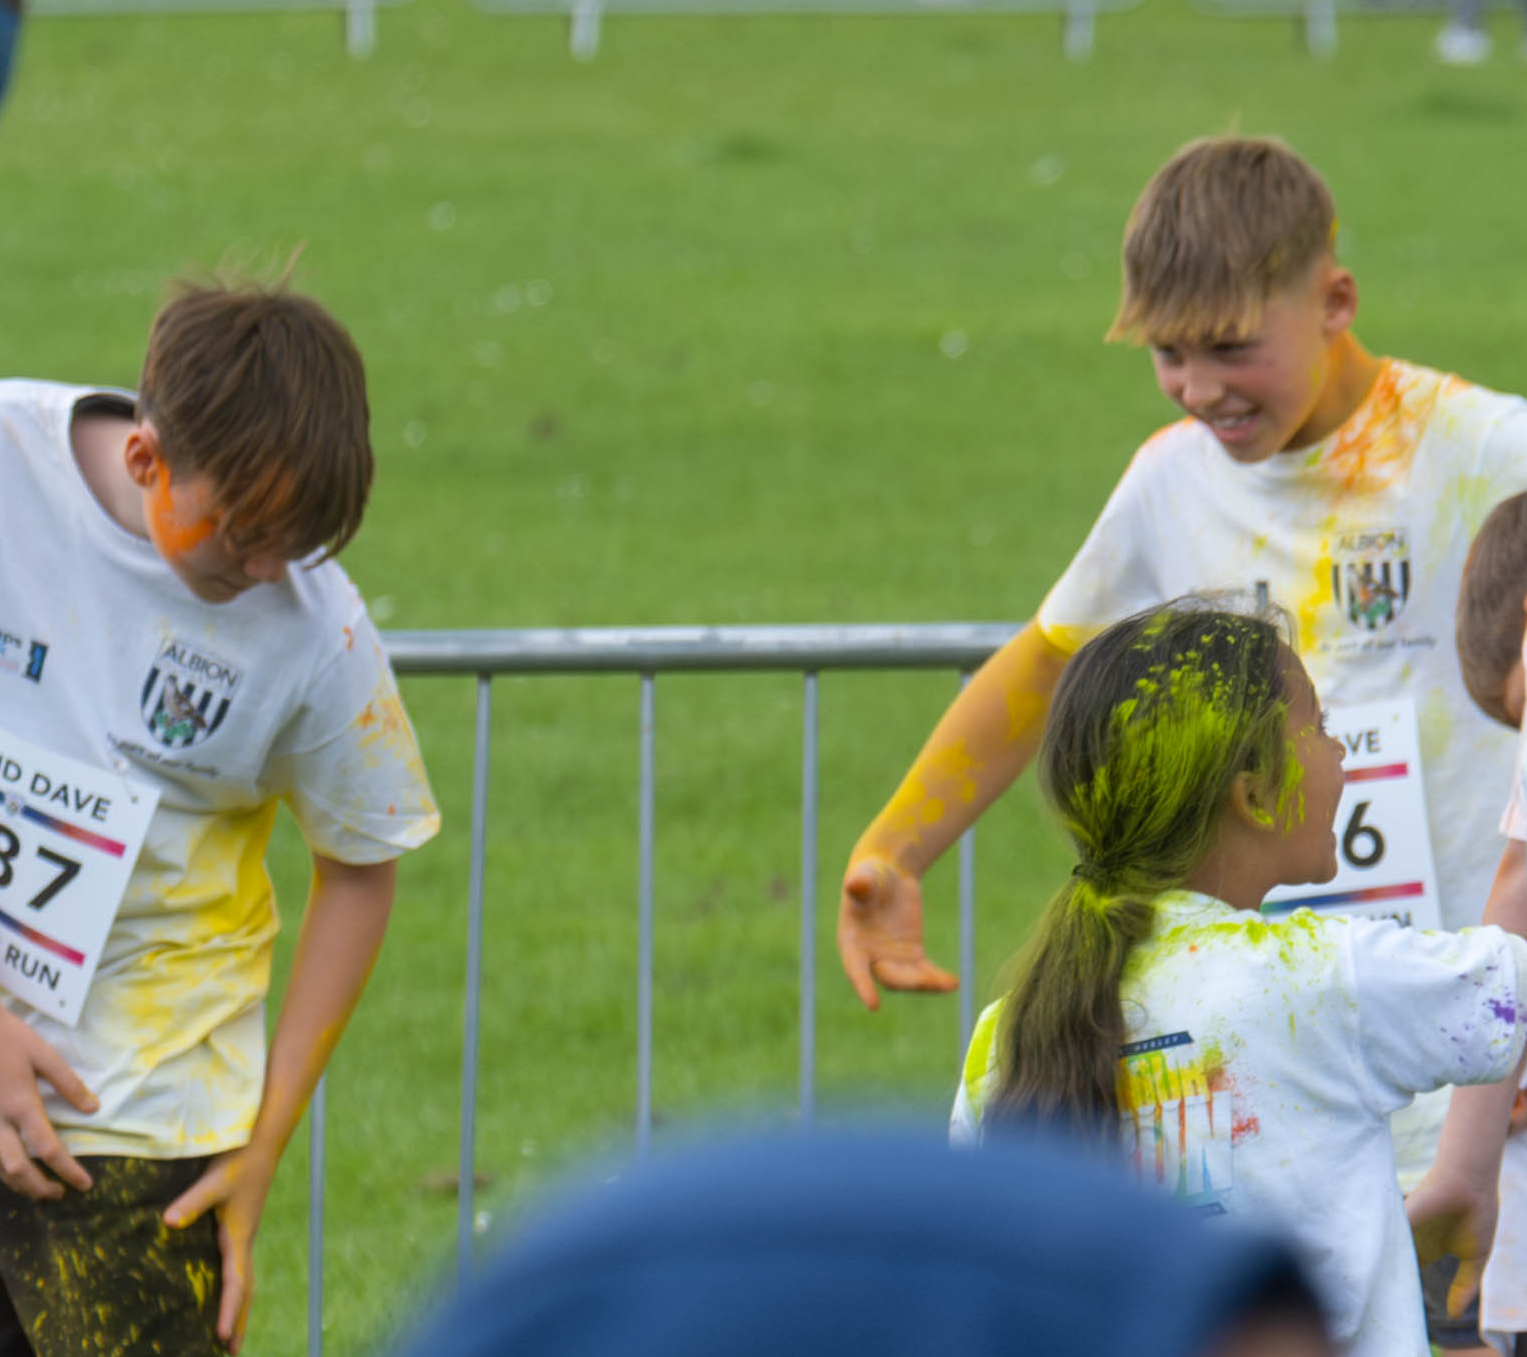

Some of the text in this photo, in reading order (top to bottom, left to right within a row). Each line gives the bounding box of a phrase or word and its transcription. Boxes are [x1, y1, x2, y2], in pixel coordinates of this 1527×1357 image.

[163, 641, 239, 688] ALBION
[1345, 728, 1382, 755] VE
[29, 772, 113, 823] DAVE
[1342, 800, 1385, 870] 6
[4, 944, 62, 991] RUN
